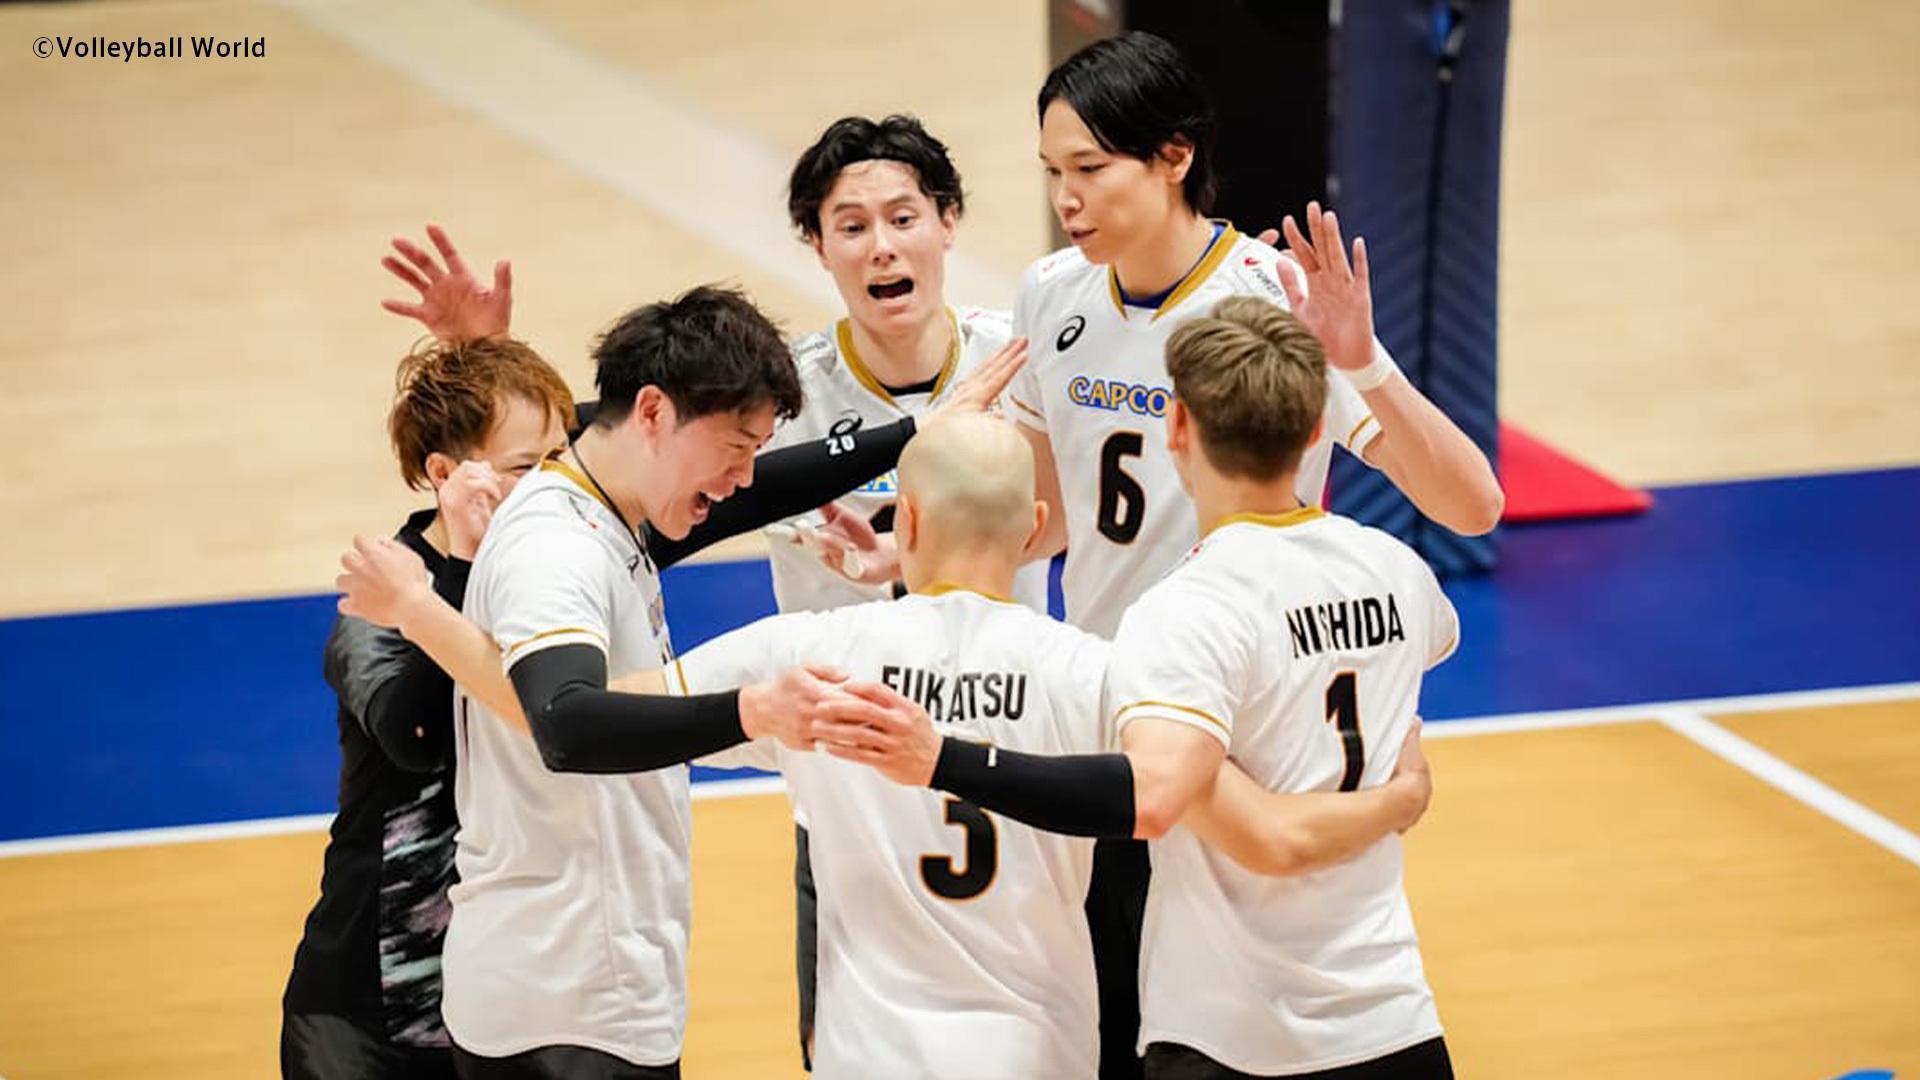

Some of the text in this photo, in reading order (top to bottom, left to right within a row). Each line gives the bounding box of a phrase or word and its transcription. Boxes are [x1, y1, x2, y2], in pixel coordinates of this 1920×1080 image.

[826, 434, 856, 456] 20
[1097, 429, 1145, 546] 6
[1285, 592, 1405, 659] NISHIDA
[1324, 671, 1365, 793] 1
[919, 797, 998, 903] 3
